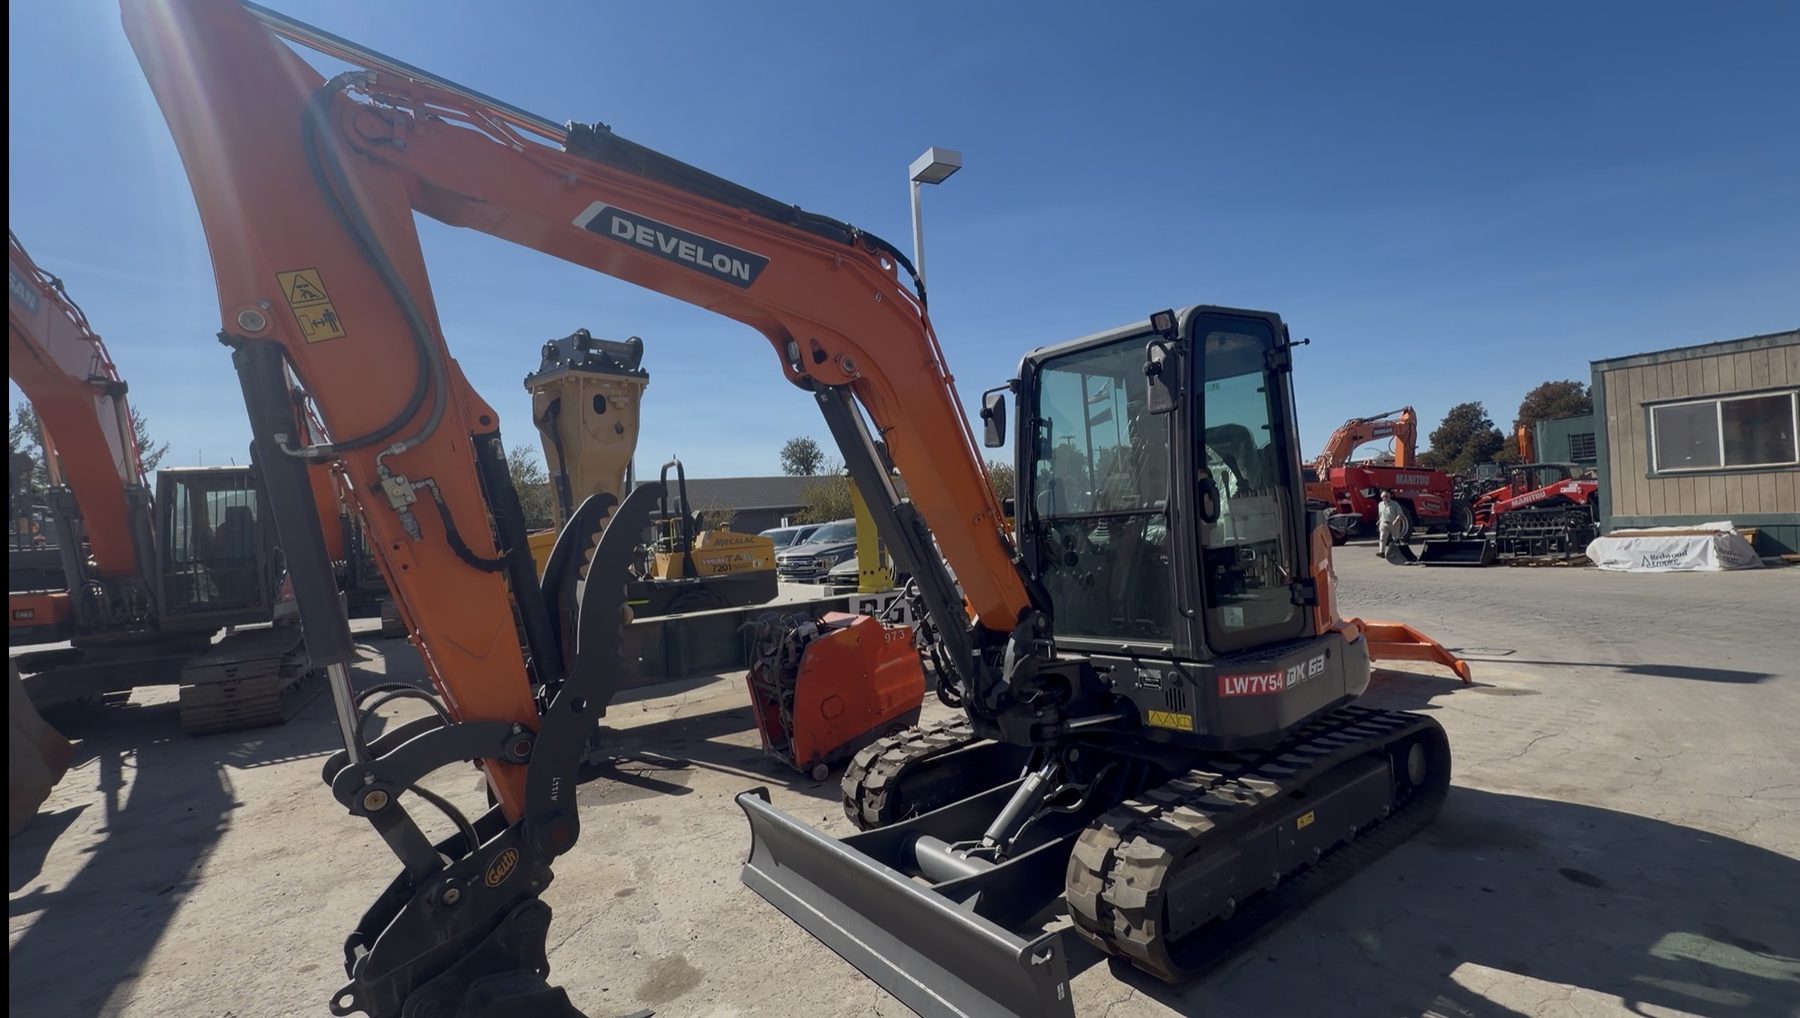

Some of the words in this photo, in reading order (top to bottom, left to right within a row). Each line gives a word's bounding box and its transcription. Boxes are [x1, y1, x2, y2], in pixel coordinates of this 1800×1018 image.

[611, 215, 750, 281] DEVELON
[1396, 474, 1430, 485] MANITOU
[1511, 491, 1546, 507] MANITOU
[1650, 550, 1688, 561] Redwood
[712, 563, 732, 573] 7201
[1650, 558, 1679, 568] Empire
[884, 629, 905, 643] 973
[1225, 674, 1283, 695] LW7Y54
[1308, 654, 1325, 678] 63
